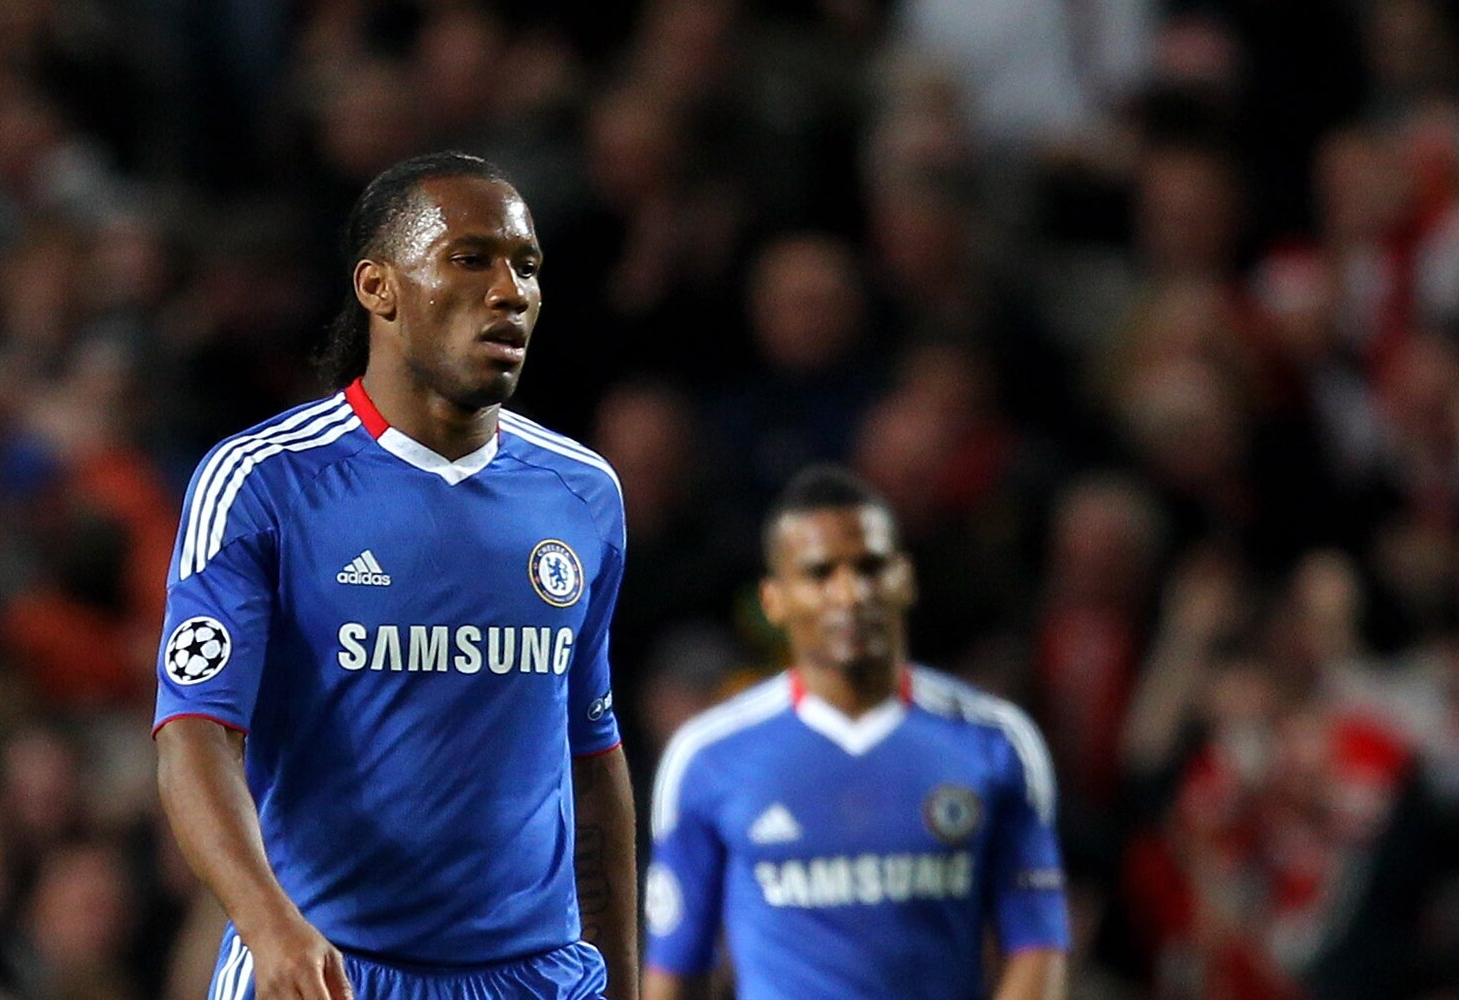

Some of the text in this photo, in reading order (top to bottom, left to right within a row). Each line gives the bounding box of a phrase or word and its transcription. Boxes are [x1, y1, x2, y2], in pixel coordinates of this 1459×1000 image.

[336, 571, 392, 586] adidas
[337, 622, 574, 675] SAMSUNG
[754, 852, 973, 909] SAMSUNG
